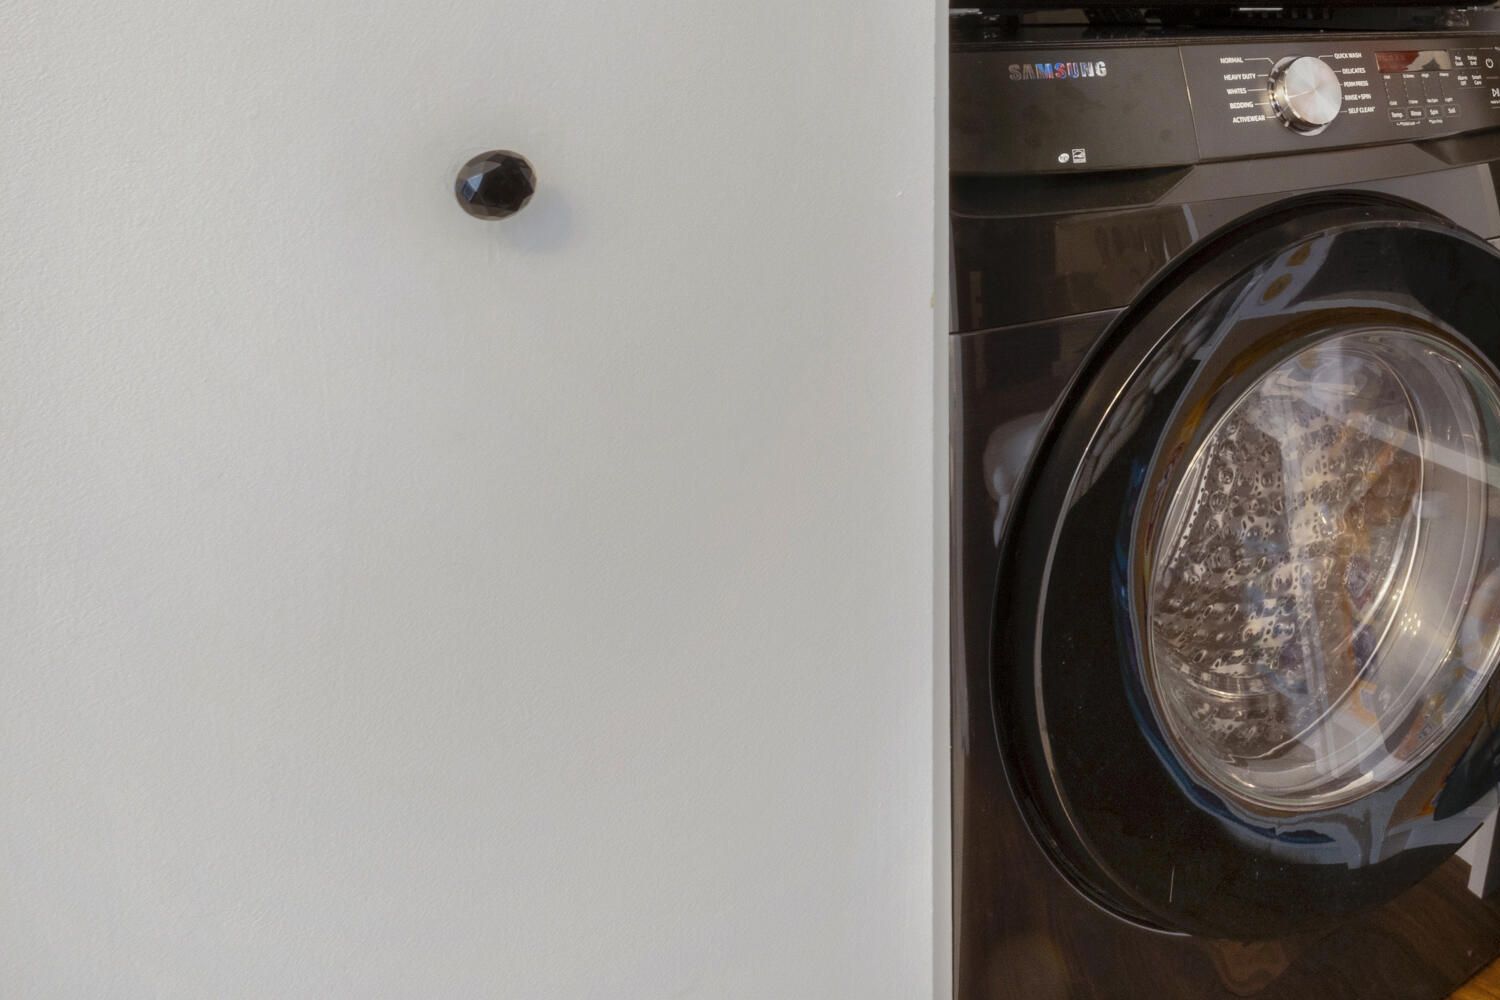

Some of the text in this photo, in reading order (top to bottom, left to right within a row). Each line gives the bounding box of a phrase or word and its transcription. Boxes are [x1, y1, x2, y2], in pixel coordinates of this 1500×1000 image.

[1008, 61, 1107, 81] SAMSUNG
[1223, 72, 1256, 81] HEAVY DUTY
[1226, 87, 1247, 95] WHITES
